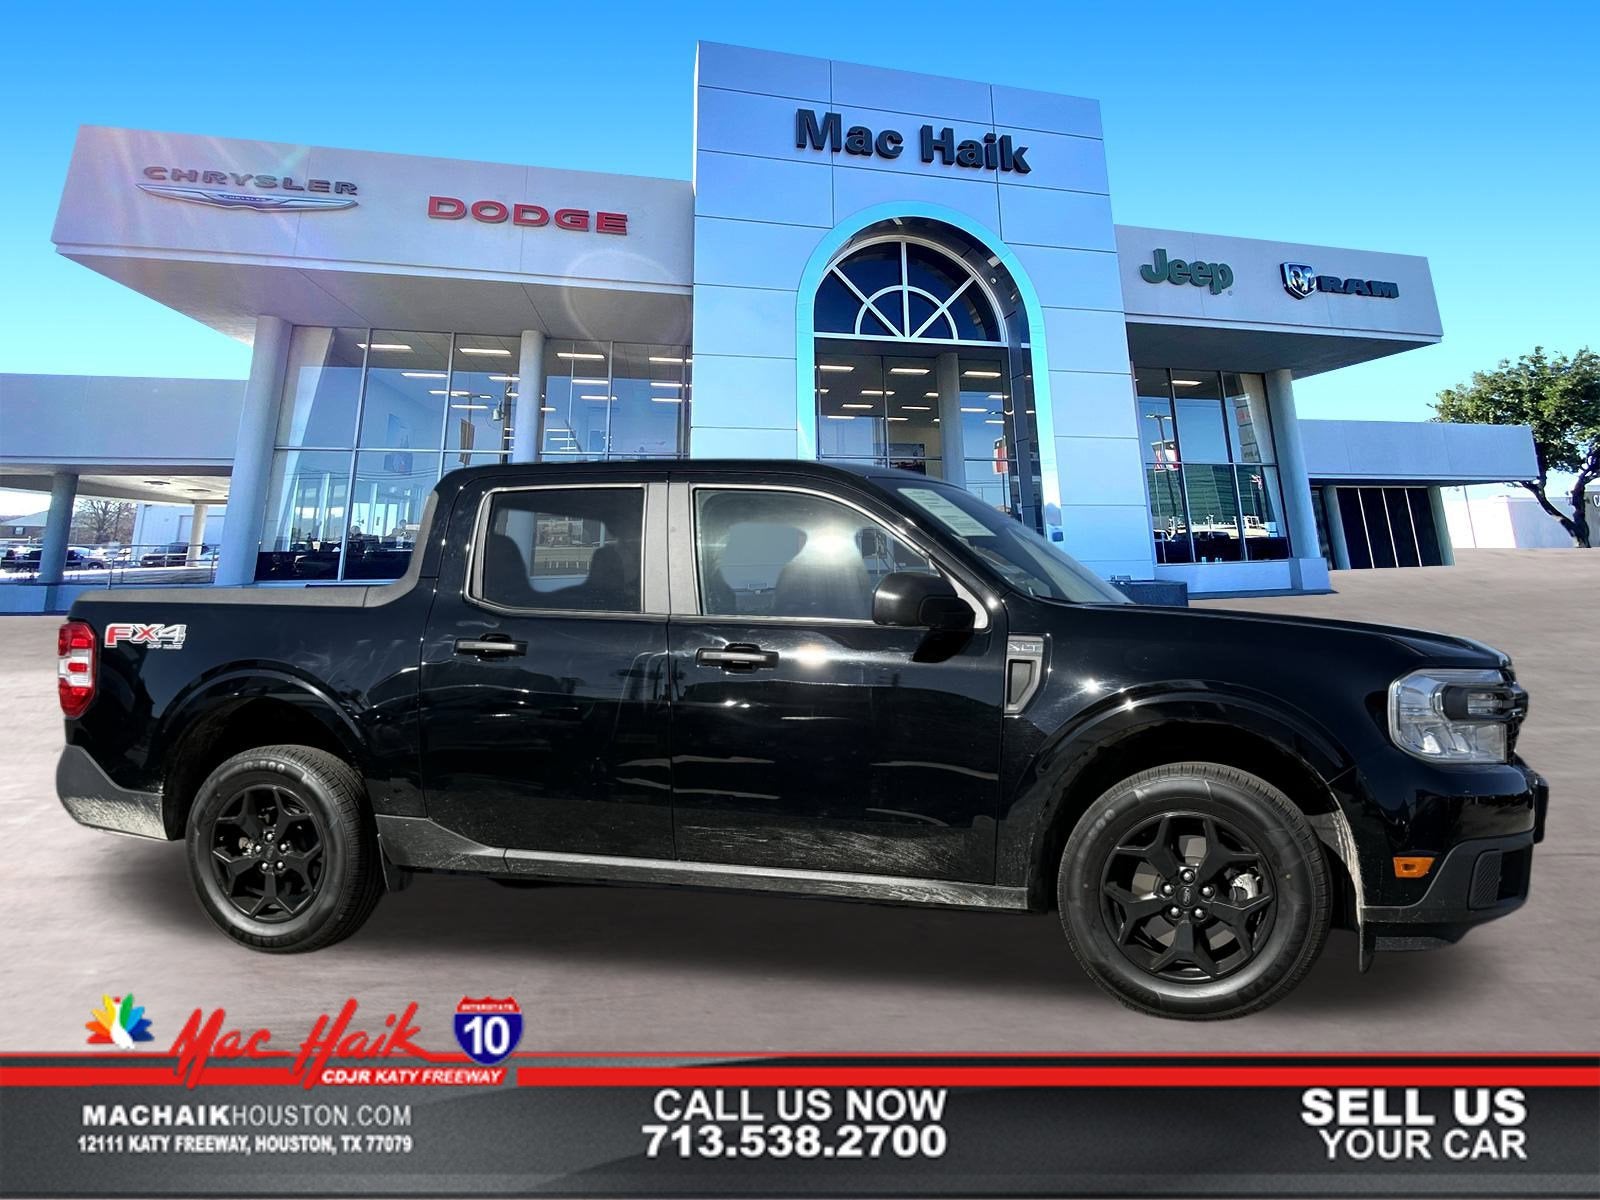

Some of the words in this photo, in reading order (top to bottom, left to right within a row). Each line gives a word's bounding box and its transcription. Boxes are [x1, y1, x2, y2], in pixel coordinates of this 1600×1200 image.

[795, 108, 904, 158] Mac
[919, 124, 1032, 174] Haik
[143, 166, 358, 196] CHRYSLER
[428, 195, 628, 236] DODGE
[1140, 248, 1234, 295] Jeep
[1316, 275, 1400, 299] RAM
[104, 623, 187, 648] FX4
